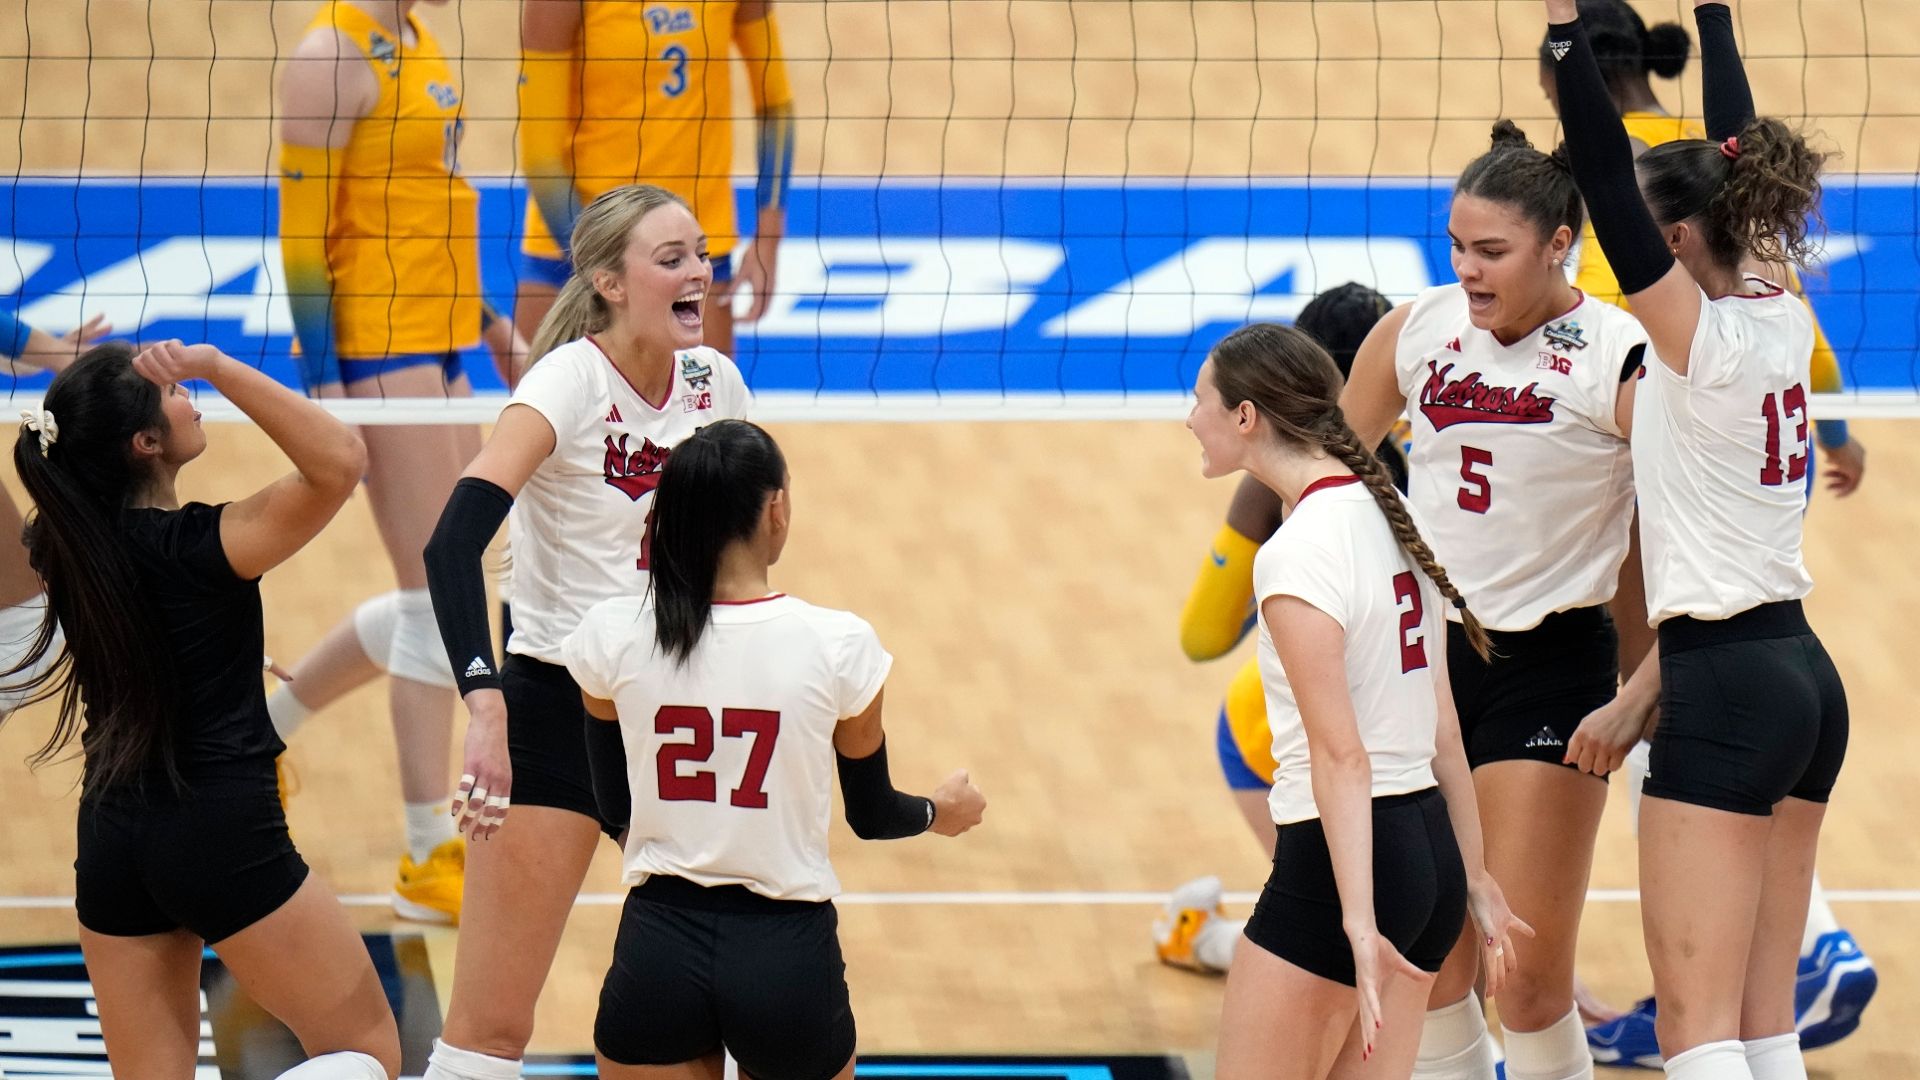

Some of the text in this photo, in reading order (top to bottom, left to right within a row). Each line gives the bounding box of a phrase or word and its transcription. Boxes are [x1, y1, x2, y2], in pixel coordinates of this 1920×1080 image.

[661, 45, 688, 97] 3
[1419, 359, 1558, 418] Nebraska
[1760, 382, 1809, 486] 13
[1456, 444, 1493, 515] 5
[1392, 570, 1428, 675] 2
[465, 667, 491, 678] adidas
[654, 704, 781, 810] 27
